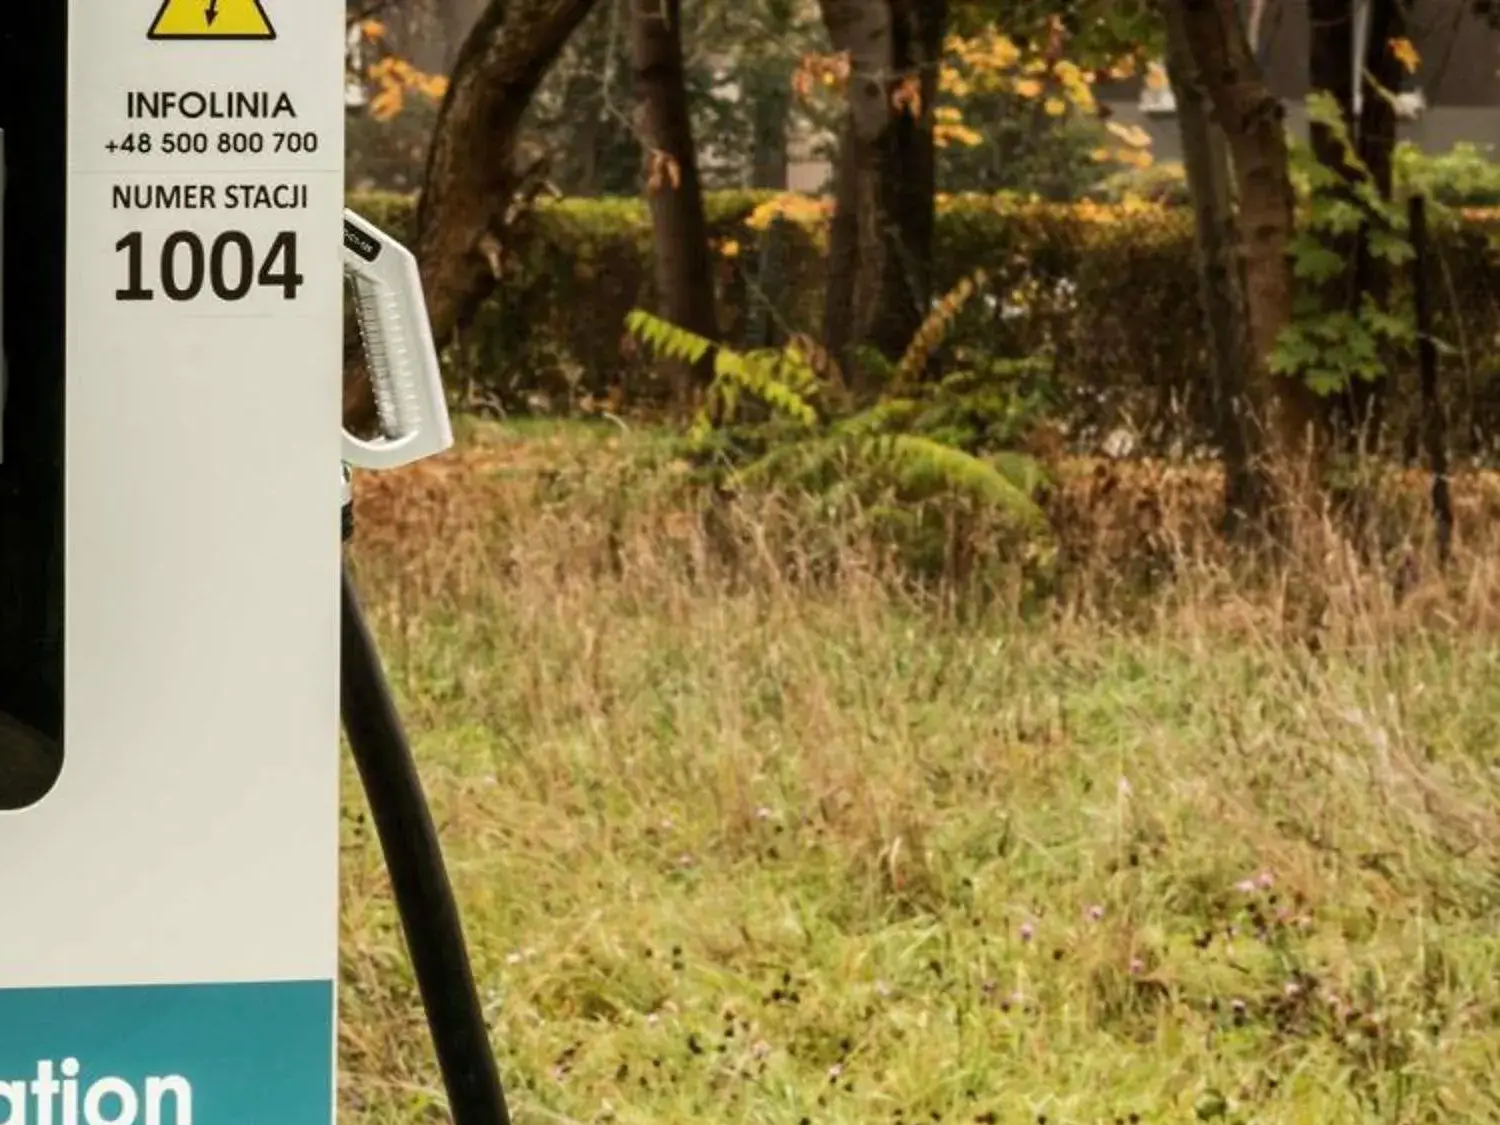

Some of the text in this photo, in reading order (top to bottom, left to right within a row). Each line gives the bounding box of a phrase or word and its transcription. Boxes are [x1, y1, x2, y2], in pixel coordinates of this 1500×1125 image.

[126, 91, 297, 119] INFOLINIA
[105, 132, 319, 153] +48 500 800 700
[112, 184, 308, 209] NUMER STACJI
[114, 229, 304, 301] 1004
